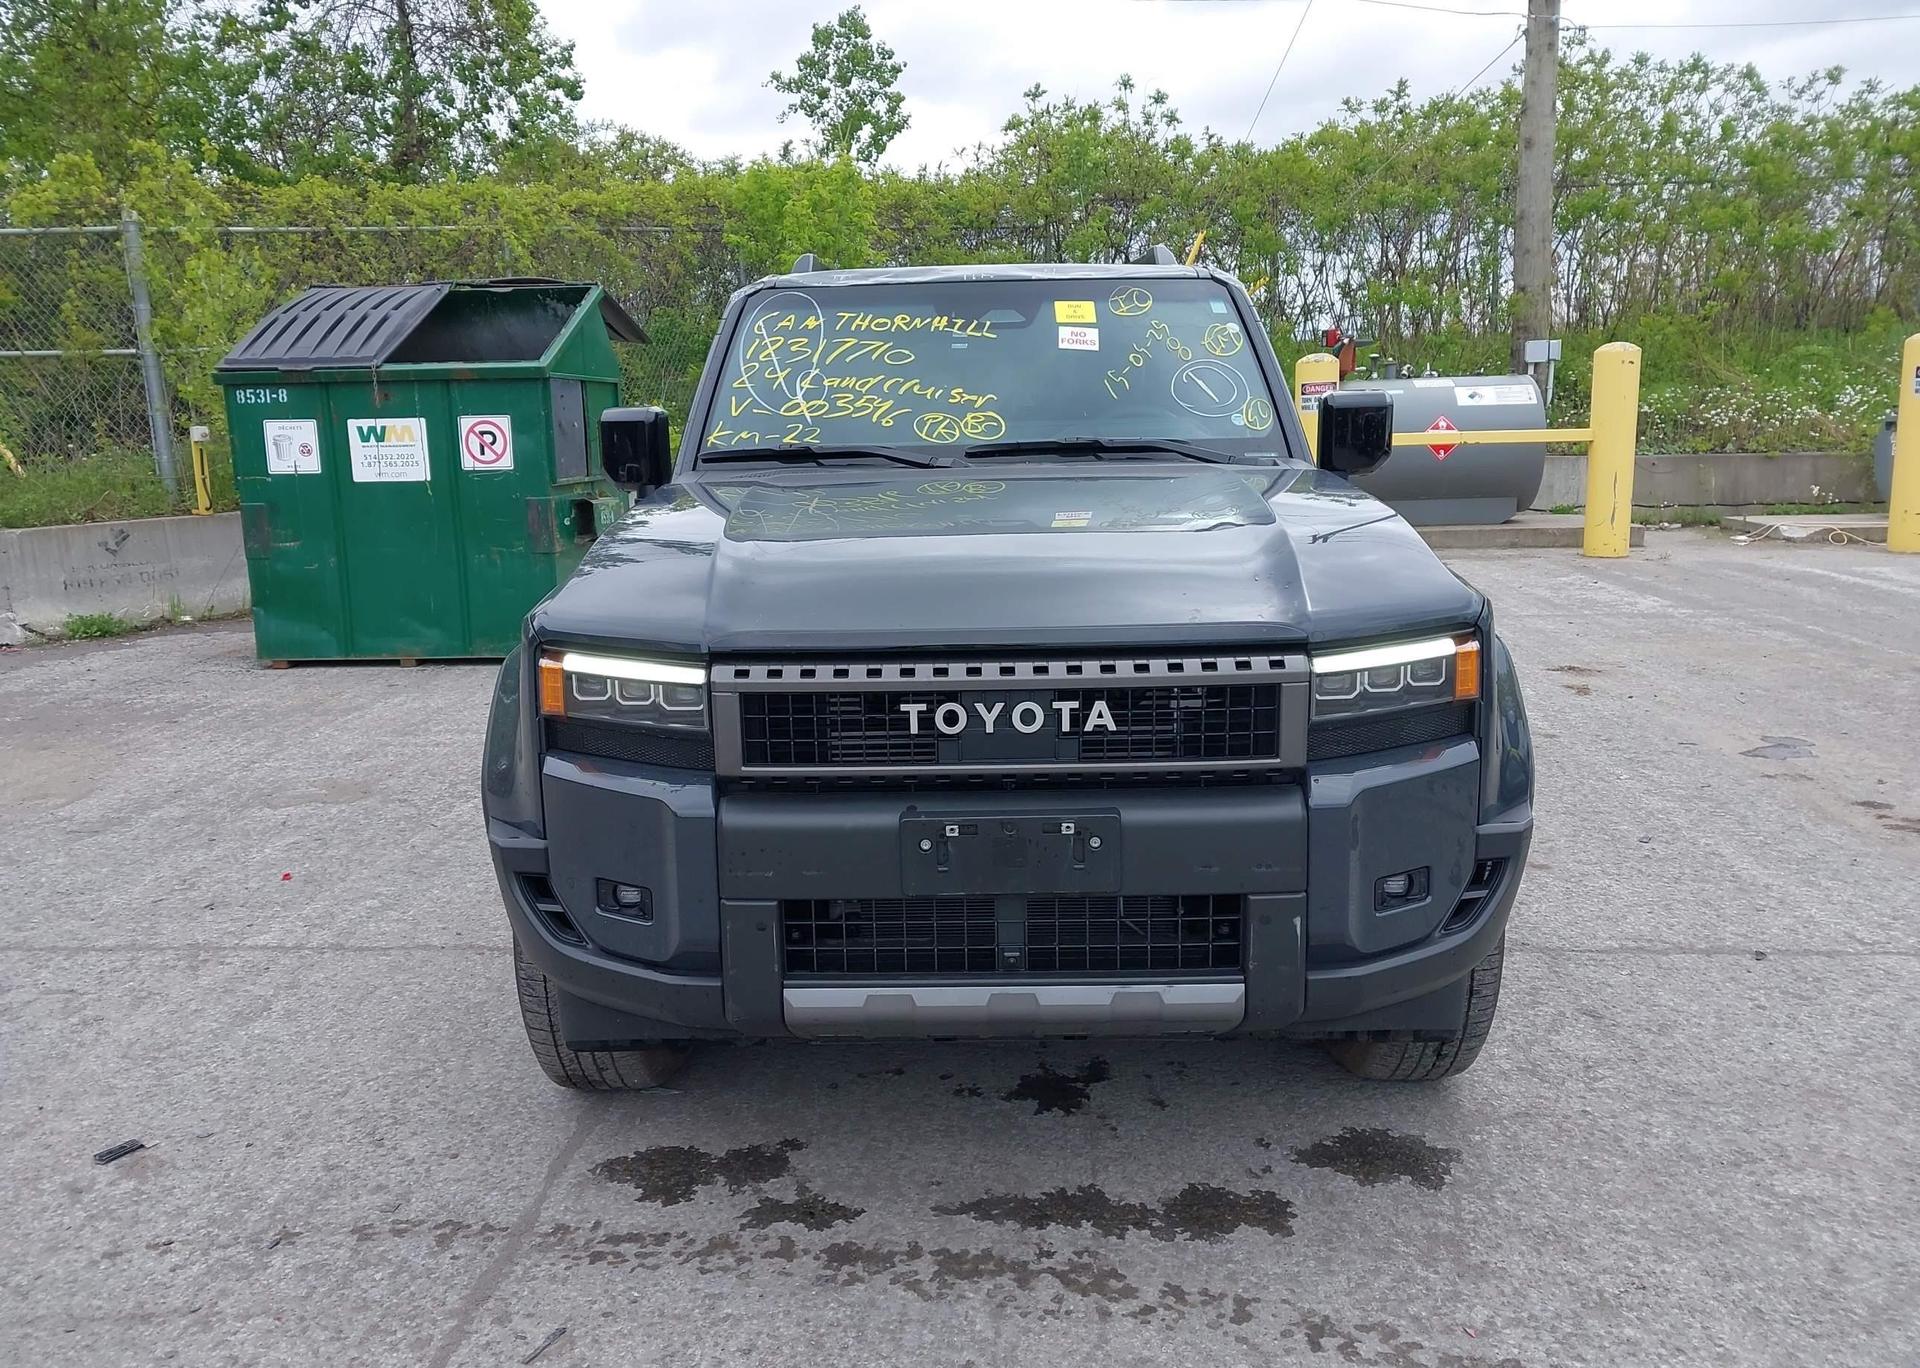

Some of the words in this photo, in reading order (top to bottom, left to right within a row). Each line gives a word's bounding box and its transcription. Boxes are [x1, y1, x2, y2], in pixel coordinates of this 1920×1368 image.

[836, 311, 998, 339] THORNHILL
[1061, 337, 1097, 346] FORKS
[236, 388, 287, 404] 8531-8
[356, 425, 415, 443] WM
[478, 430, 497, 456] P
[1438, 449, 1445, 457] 3
[900, 700, 1118, 735] TOYOTA
